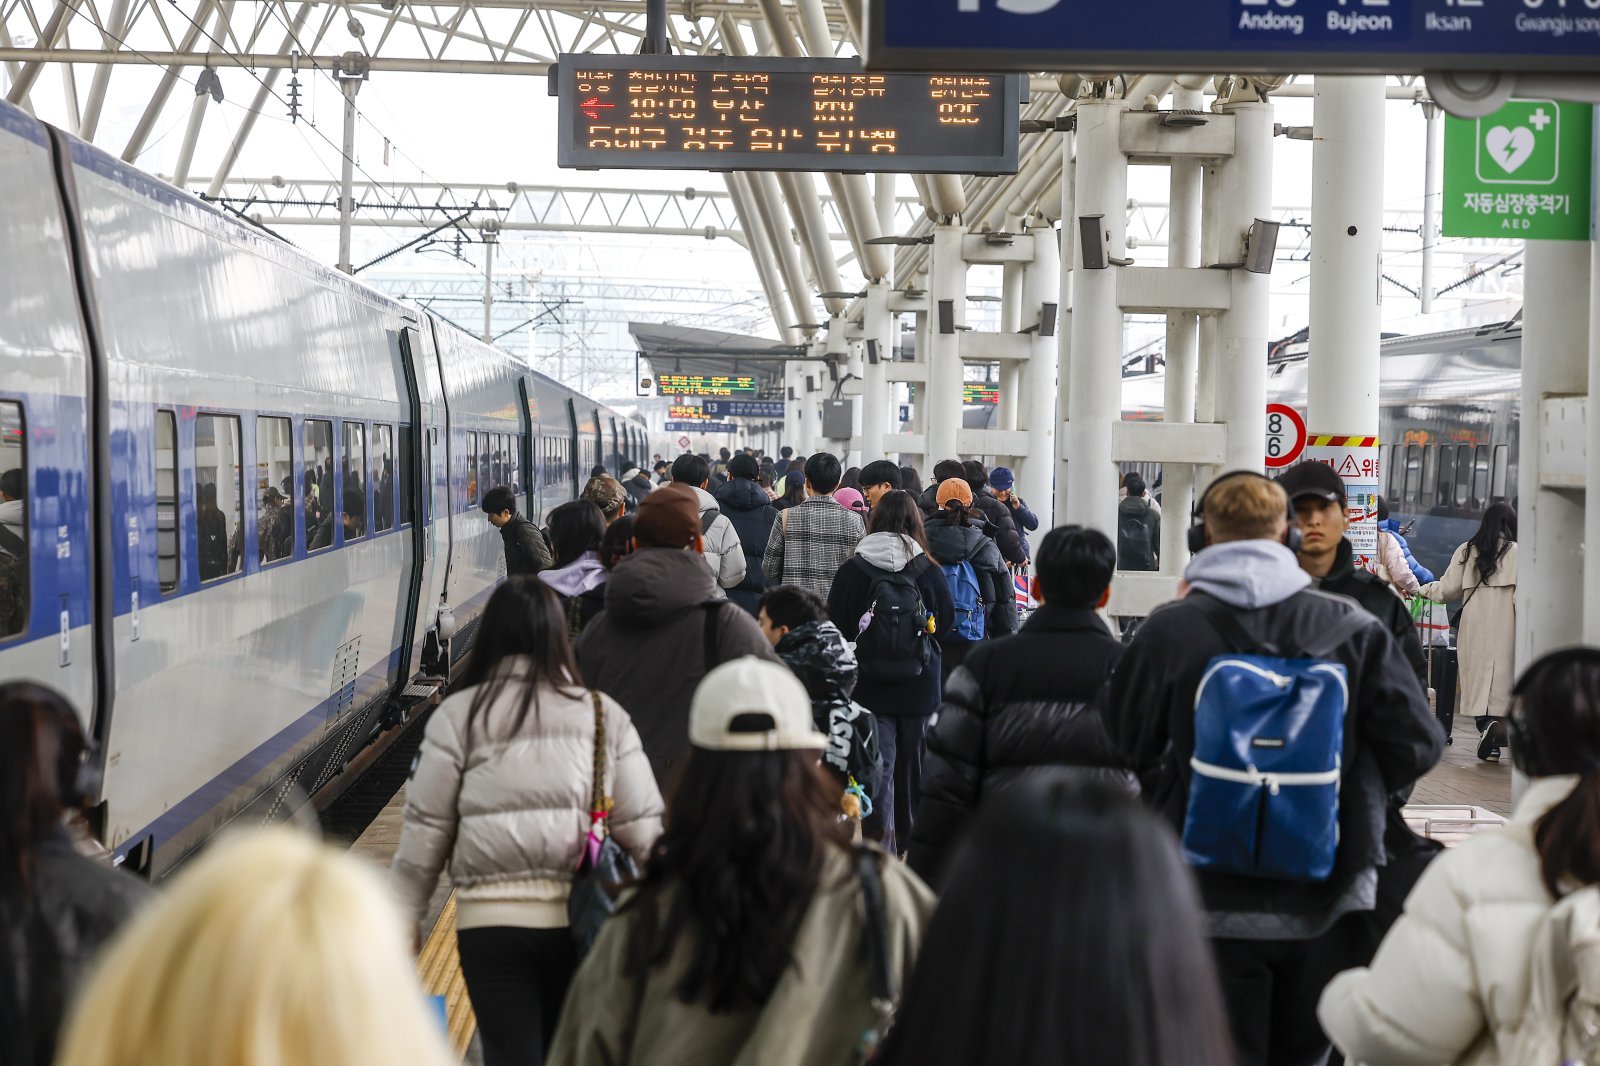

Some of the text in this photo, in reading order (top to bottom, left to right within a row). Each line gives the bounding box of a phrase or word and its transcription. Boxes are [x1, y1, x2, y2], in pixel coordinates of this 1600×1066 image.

[1239, 10, 1304, 34] Andong
[1327, 10, 1392, 34] Bujeon
[1425, 12, 1472, 30] Iksan
[1515, 12, 1573, 37] Gwangju
[1464, 192, 1569, 215] 자동심장충격기
[707, 403, 718, 413] 13
[1268, 413, 1282, 433] 8
[1268, 436, 1281, 456] 6
